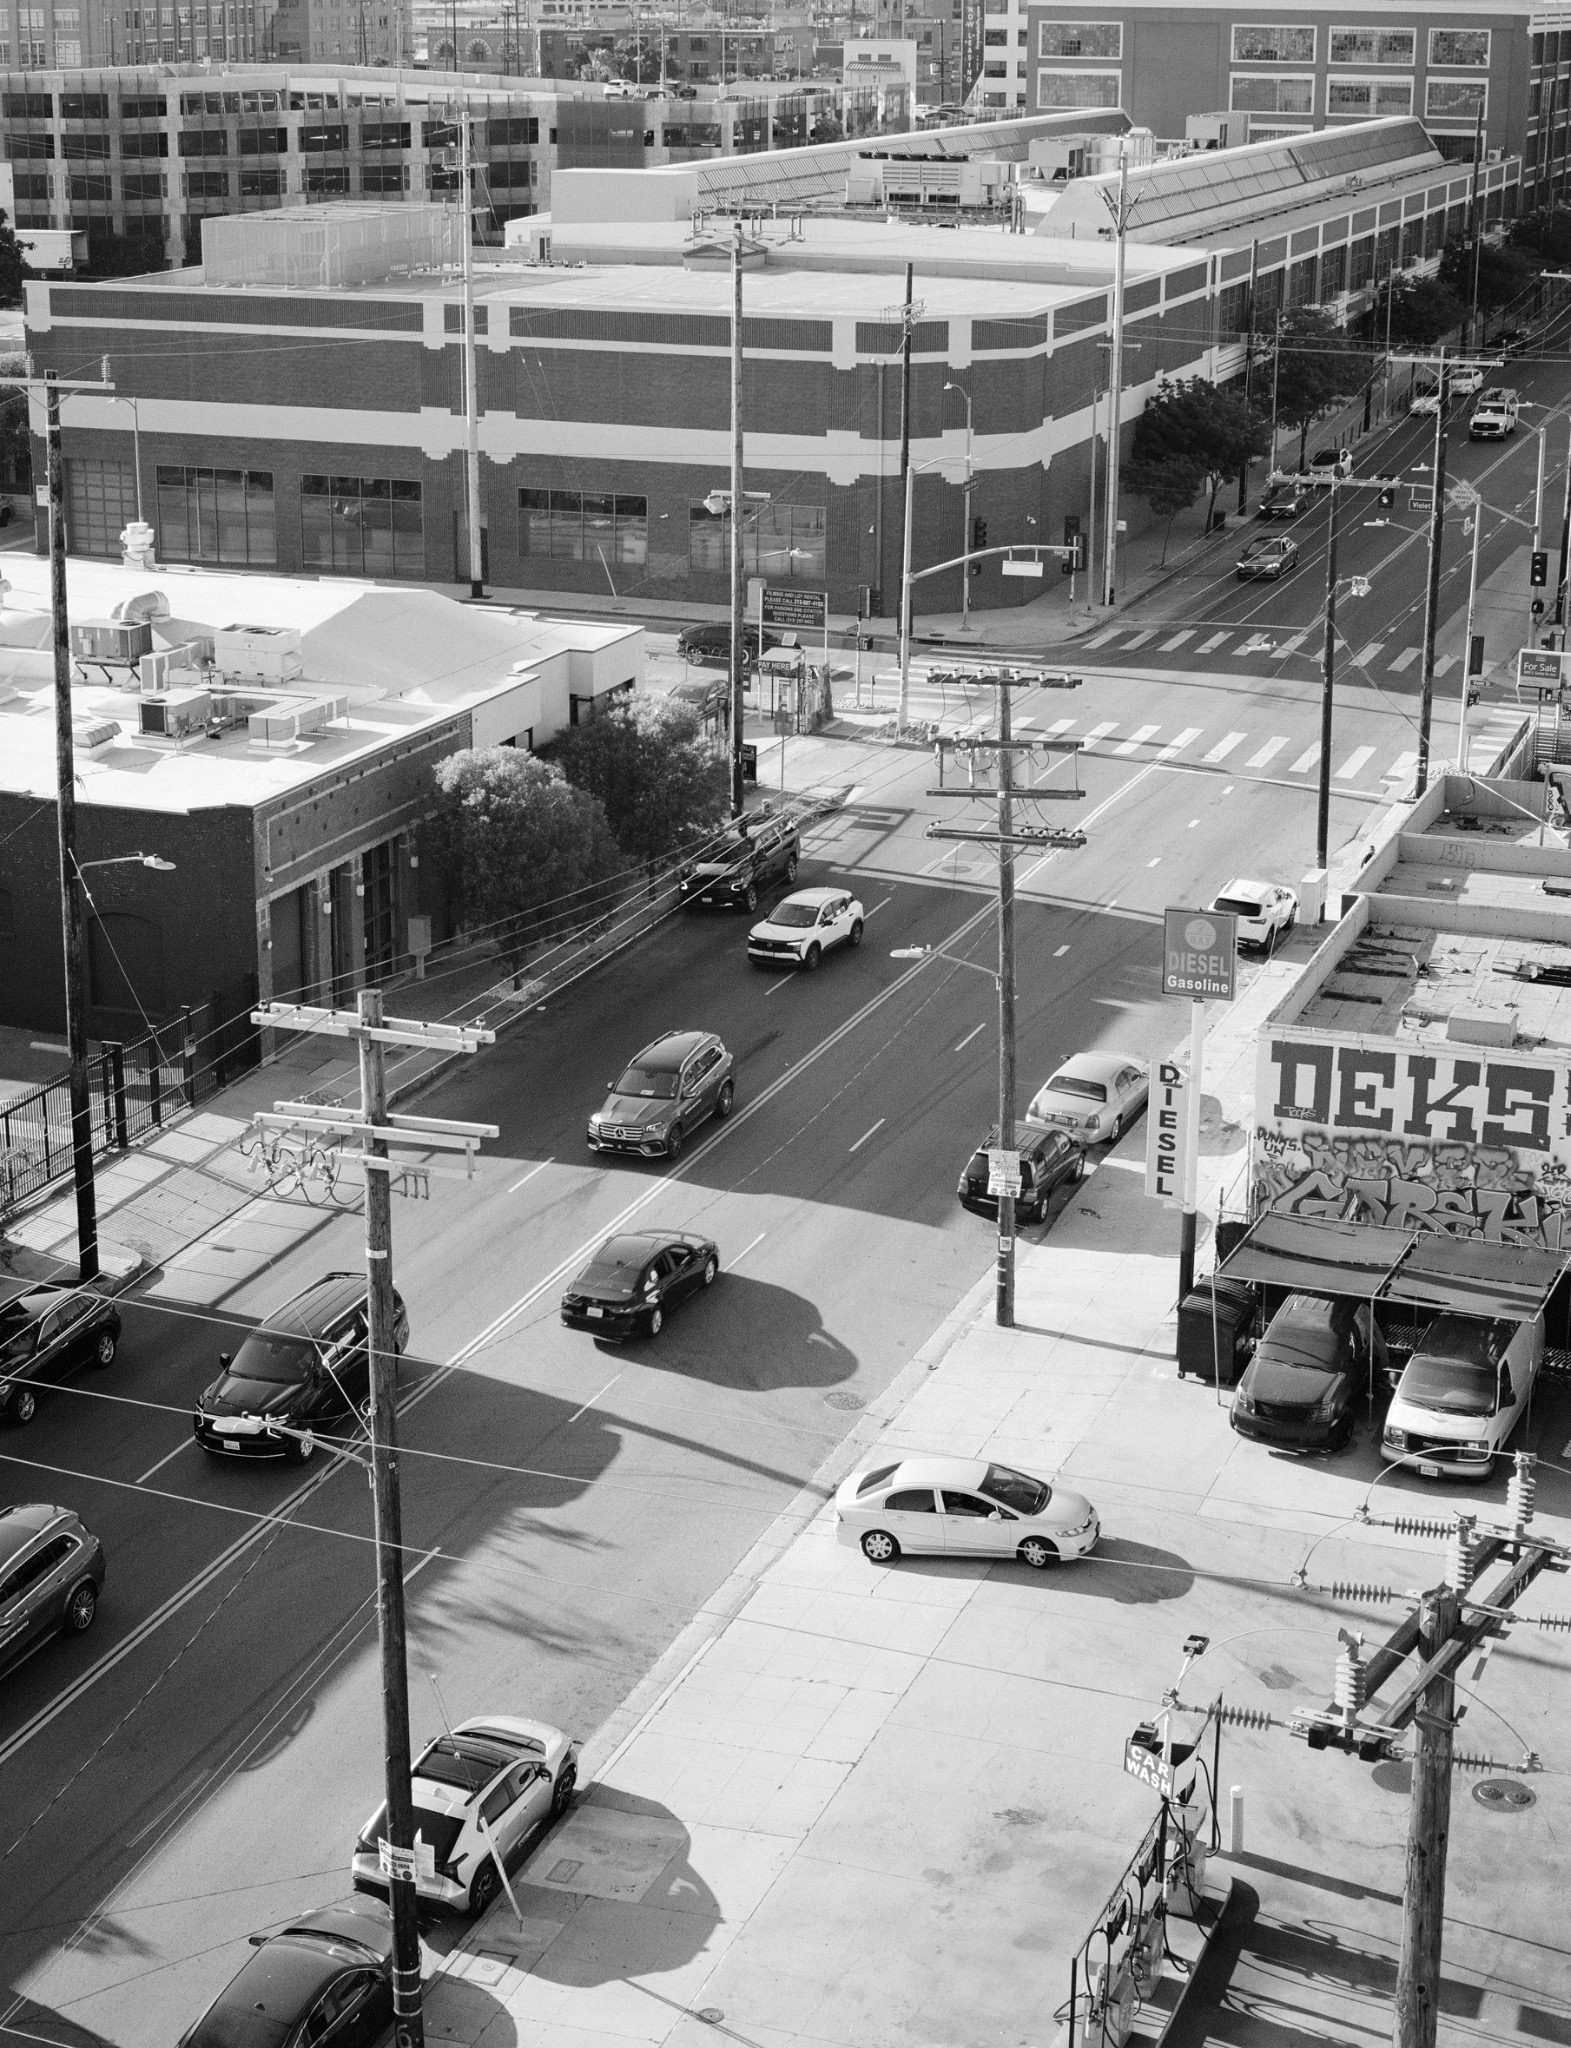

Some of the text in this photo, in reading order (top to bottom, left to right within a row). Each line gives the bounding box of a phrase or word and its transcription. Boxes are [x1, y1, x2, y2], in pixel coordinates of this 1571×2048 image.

[1412, 501, 1432, 510] Violet
[757, 661, 791, 671] PAY HERE
[1523, 661, 1557, 673] For Sale
[1168, 951, 1229, 977] DIESEL
[1167, 974, 1229, 993] Gasoline
[1156, 1064, 1181, 1197] DIESEL
[1130, 1746, 1169, 1779] CAR
[1126, 1757, 1171, 1796] WASH
